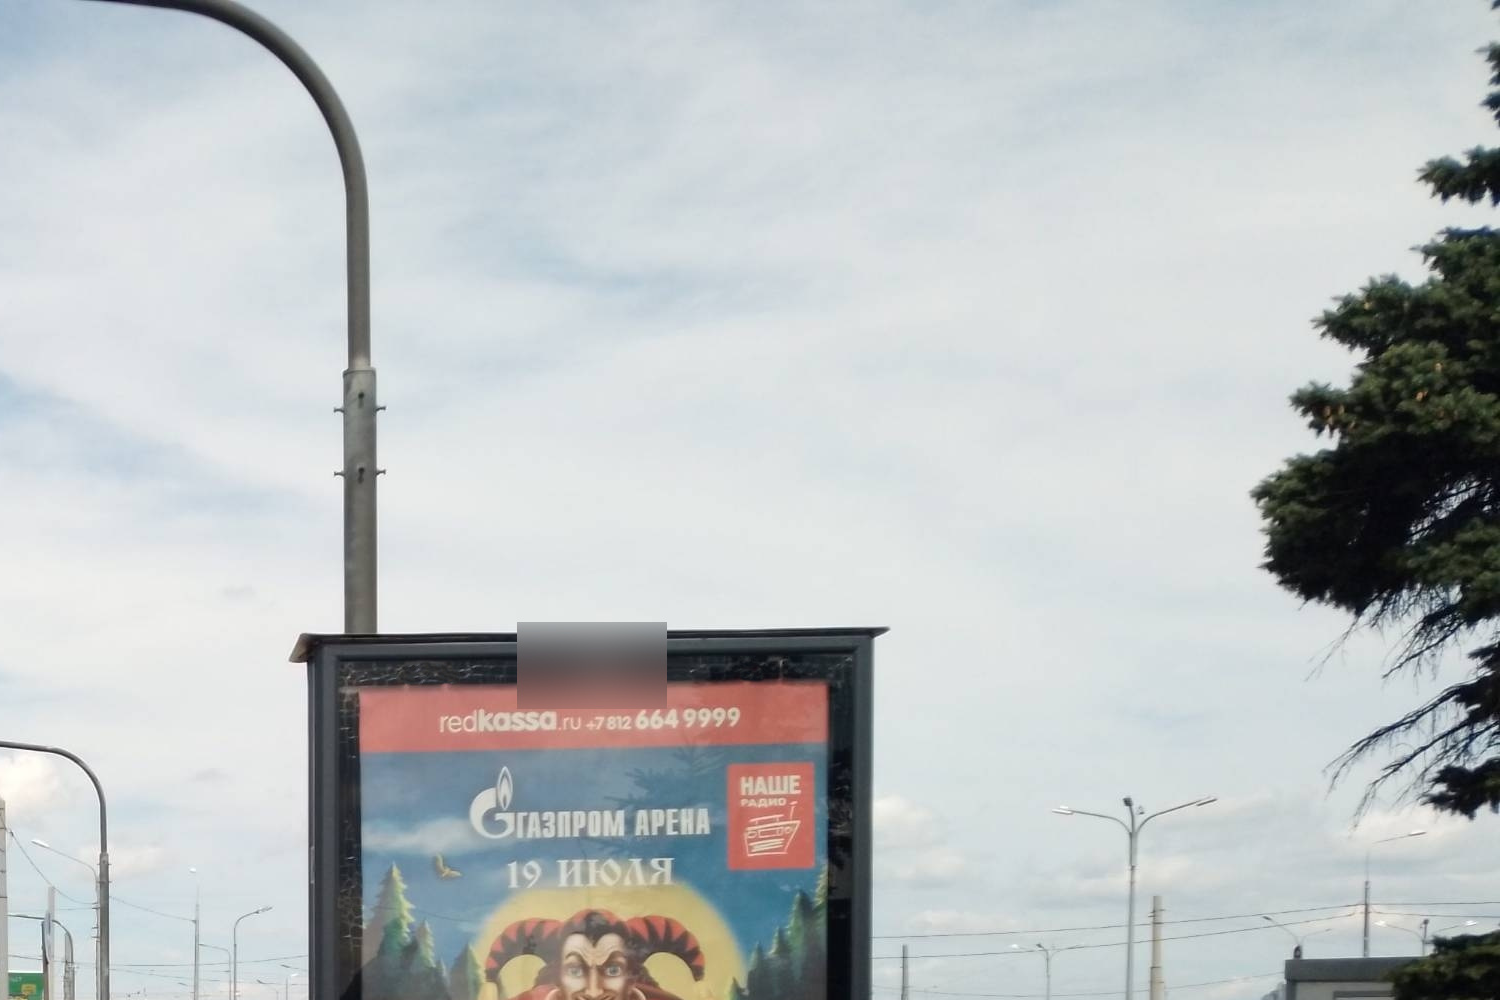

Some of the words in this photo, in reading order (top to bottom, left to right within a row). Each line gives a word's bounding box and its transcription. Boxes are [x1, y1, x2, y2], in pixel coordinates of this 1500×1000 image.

[439, 709, 581, 733] redkassa.ru
[635, 708, 680, 729] 664
[683, 707, 741, 728] 9999
[740, 775, 801, 796] НАШЕ
[740, 797, 787, 808] РАДИО
[516, 810, 625, 839] ГАЗПРОМ
[635, 808, 711, 836] АРЕНА
[507, 860, 542, 888] 19
[556, 857, 676, 888] ИЮЛЯ
